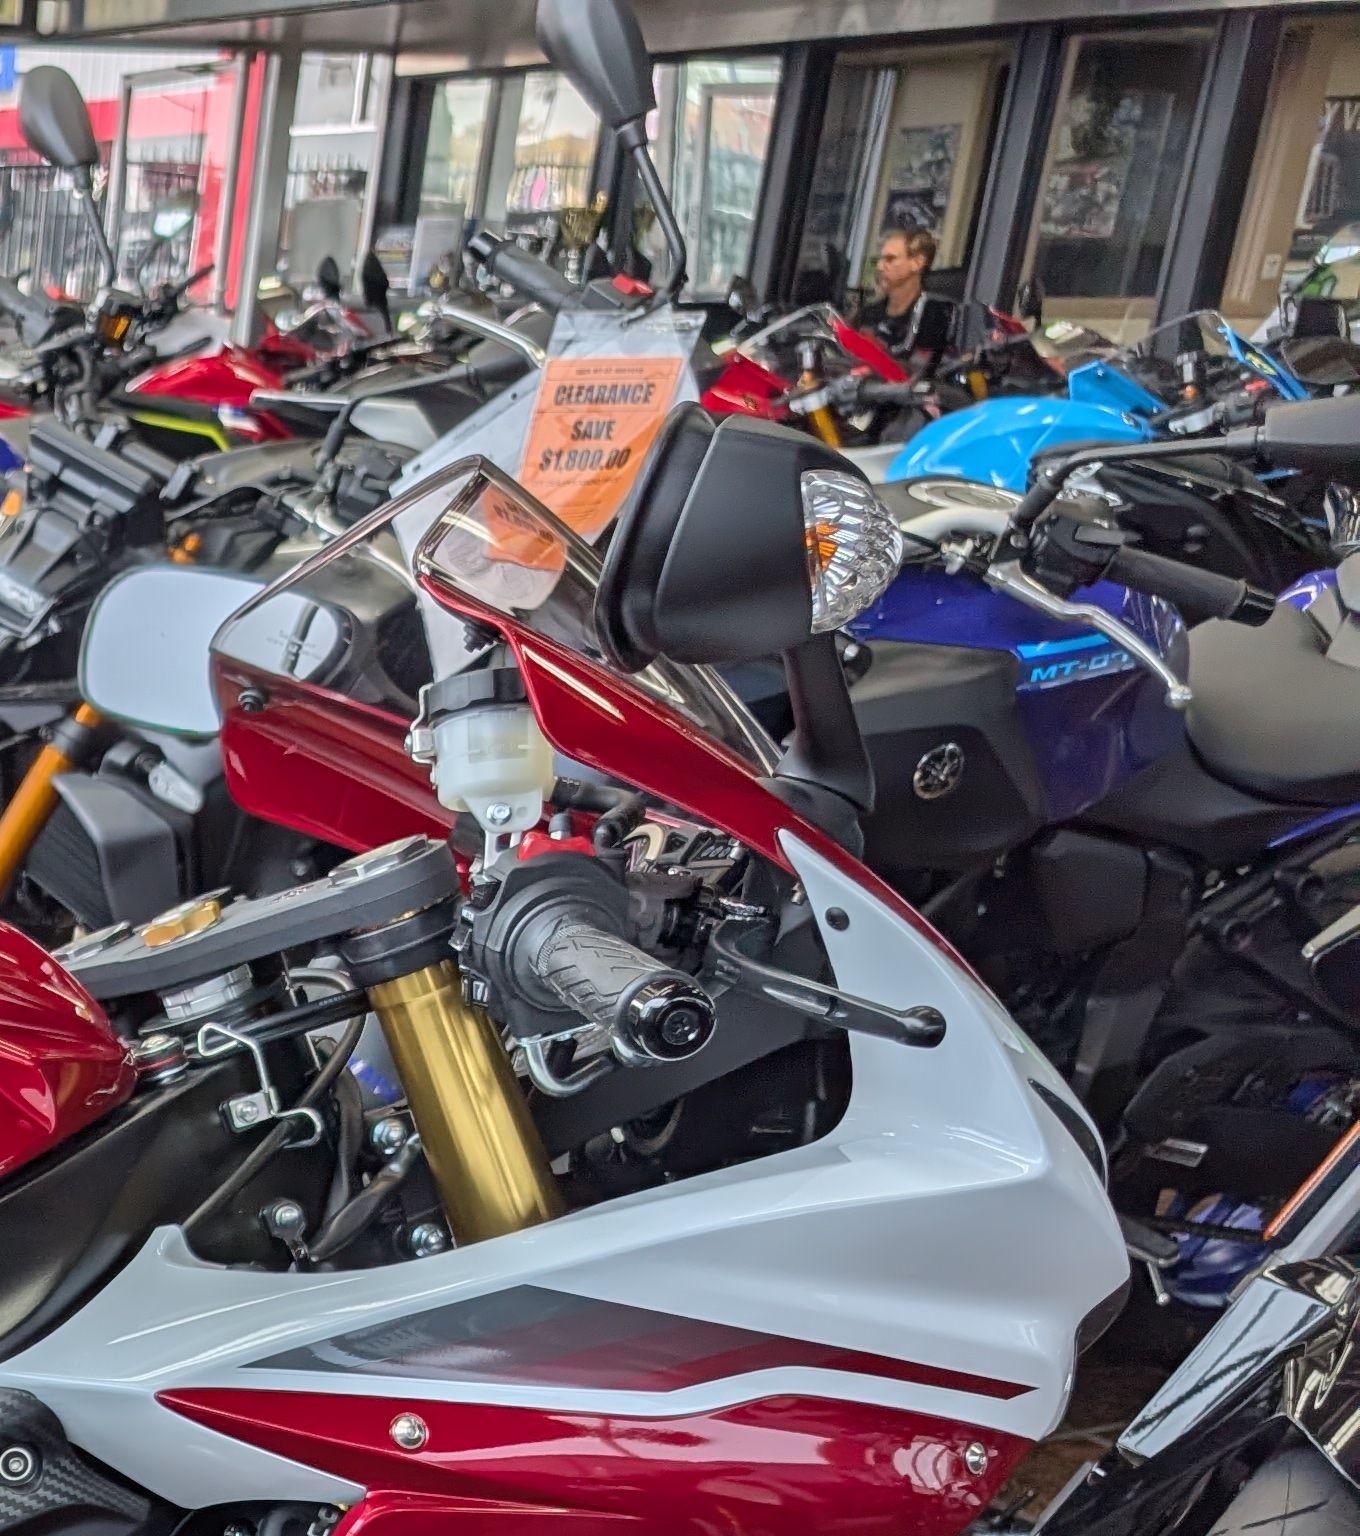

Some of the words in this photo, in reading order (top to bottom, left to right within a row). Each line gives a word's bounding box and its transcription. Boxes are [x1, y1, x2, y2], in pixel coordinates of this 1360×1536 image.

[554, 383, 656, 406] CLEARANCE
[571, 419, 616, 441] SAVE
[1030, 649, 1130, 683] MT-07
